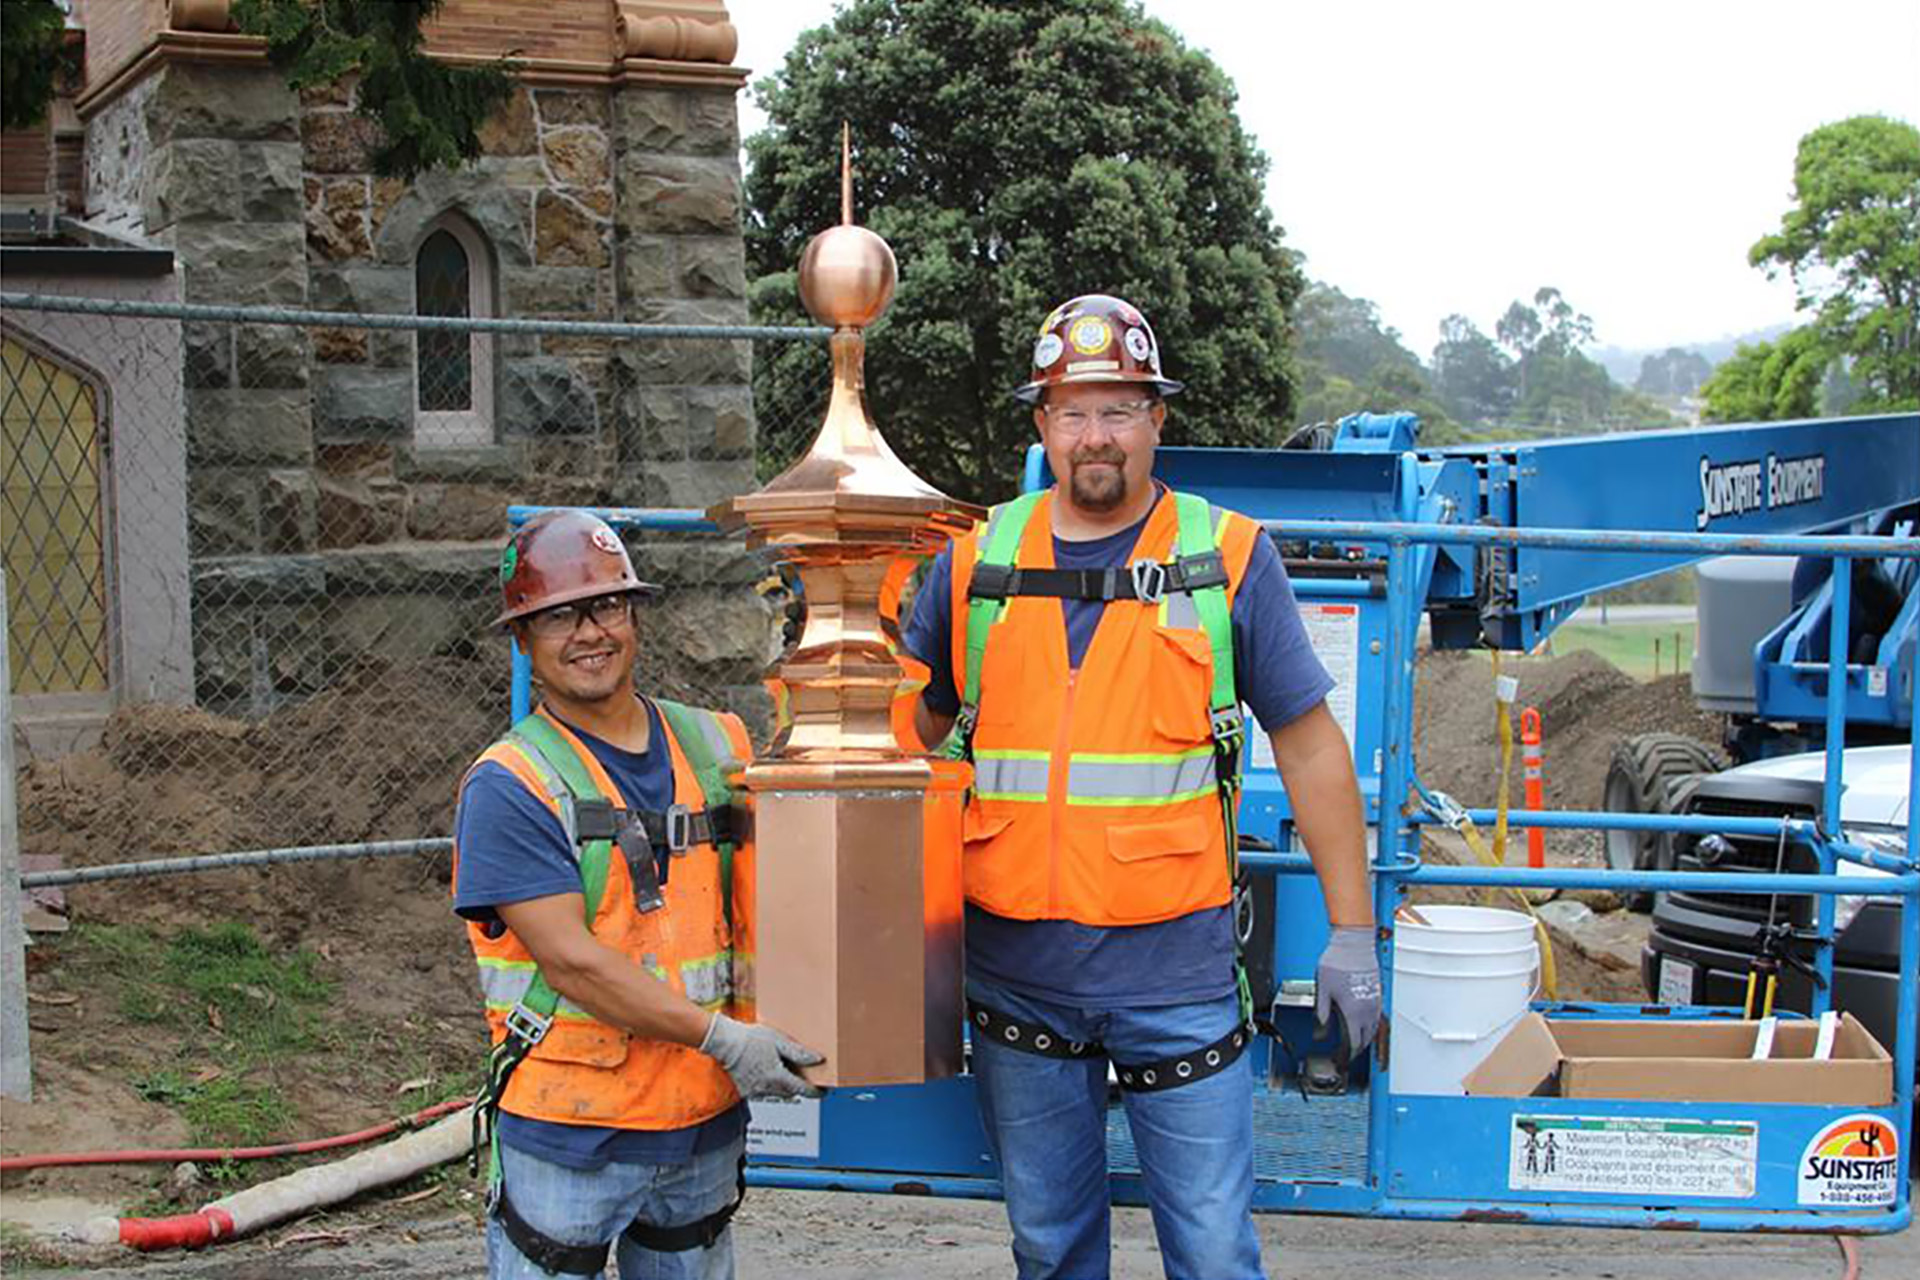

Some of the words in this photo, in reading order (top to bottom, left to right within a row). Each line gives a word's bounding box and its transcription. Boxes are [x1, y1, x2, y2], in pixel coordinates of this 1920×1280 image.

[1696, 457, 1761, 530] SUNSTATE
[1767, 454, 1823, 507] EQUIPMENT
[1566, 1145, 1622, 1157] Maximum
[1565, 1158, 1627, 1172] Occupants
[1629, 1161, 1652, 1171] and
[1655, 1163, 1716, 1175] equipment
[1804, 1156, 1896, 1180] SUNSTATE
[1827, 1181, 1876, 1191] Equipment
